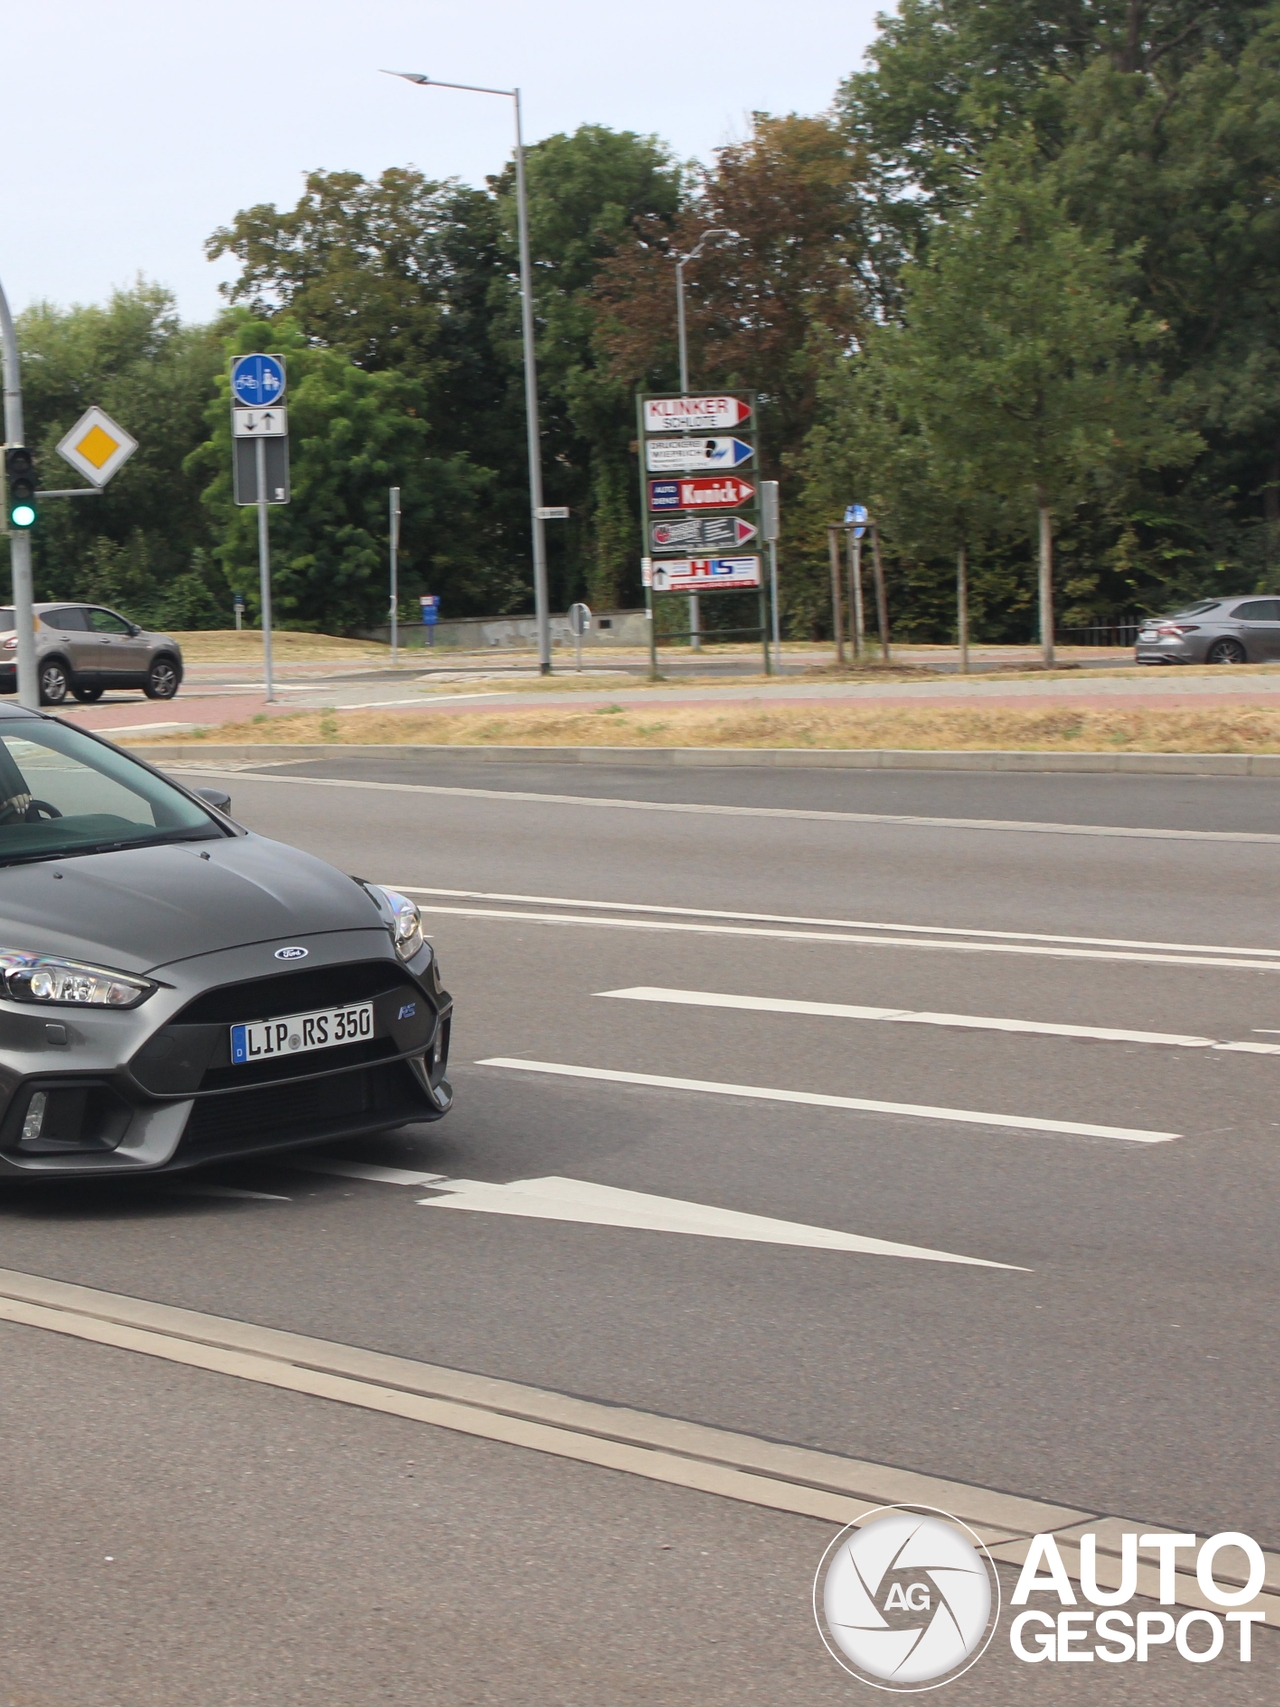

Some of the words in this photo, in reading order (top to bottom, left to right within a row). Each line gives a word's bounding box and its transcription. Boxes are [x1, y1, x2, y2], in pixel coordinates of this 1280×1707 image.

[649, 399, 729, 417] KLINKER
[662, 415, 718, 428] SCHLOTE
[650, 440, 702, 449] DRUCKEREI
[653, 485, 677, 494] AUTO
[681, 480, 739, 504] Kunick
[282, 949, 302, 958] Ford
[397, 1002, 416, 1020] RS
[236, 1047, 243, 1057] D
[248, 1023, 288, 1056] LIP
[303, 1015, 329, 1047] RS
[334, 1008, 371, 1041] 350
